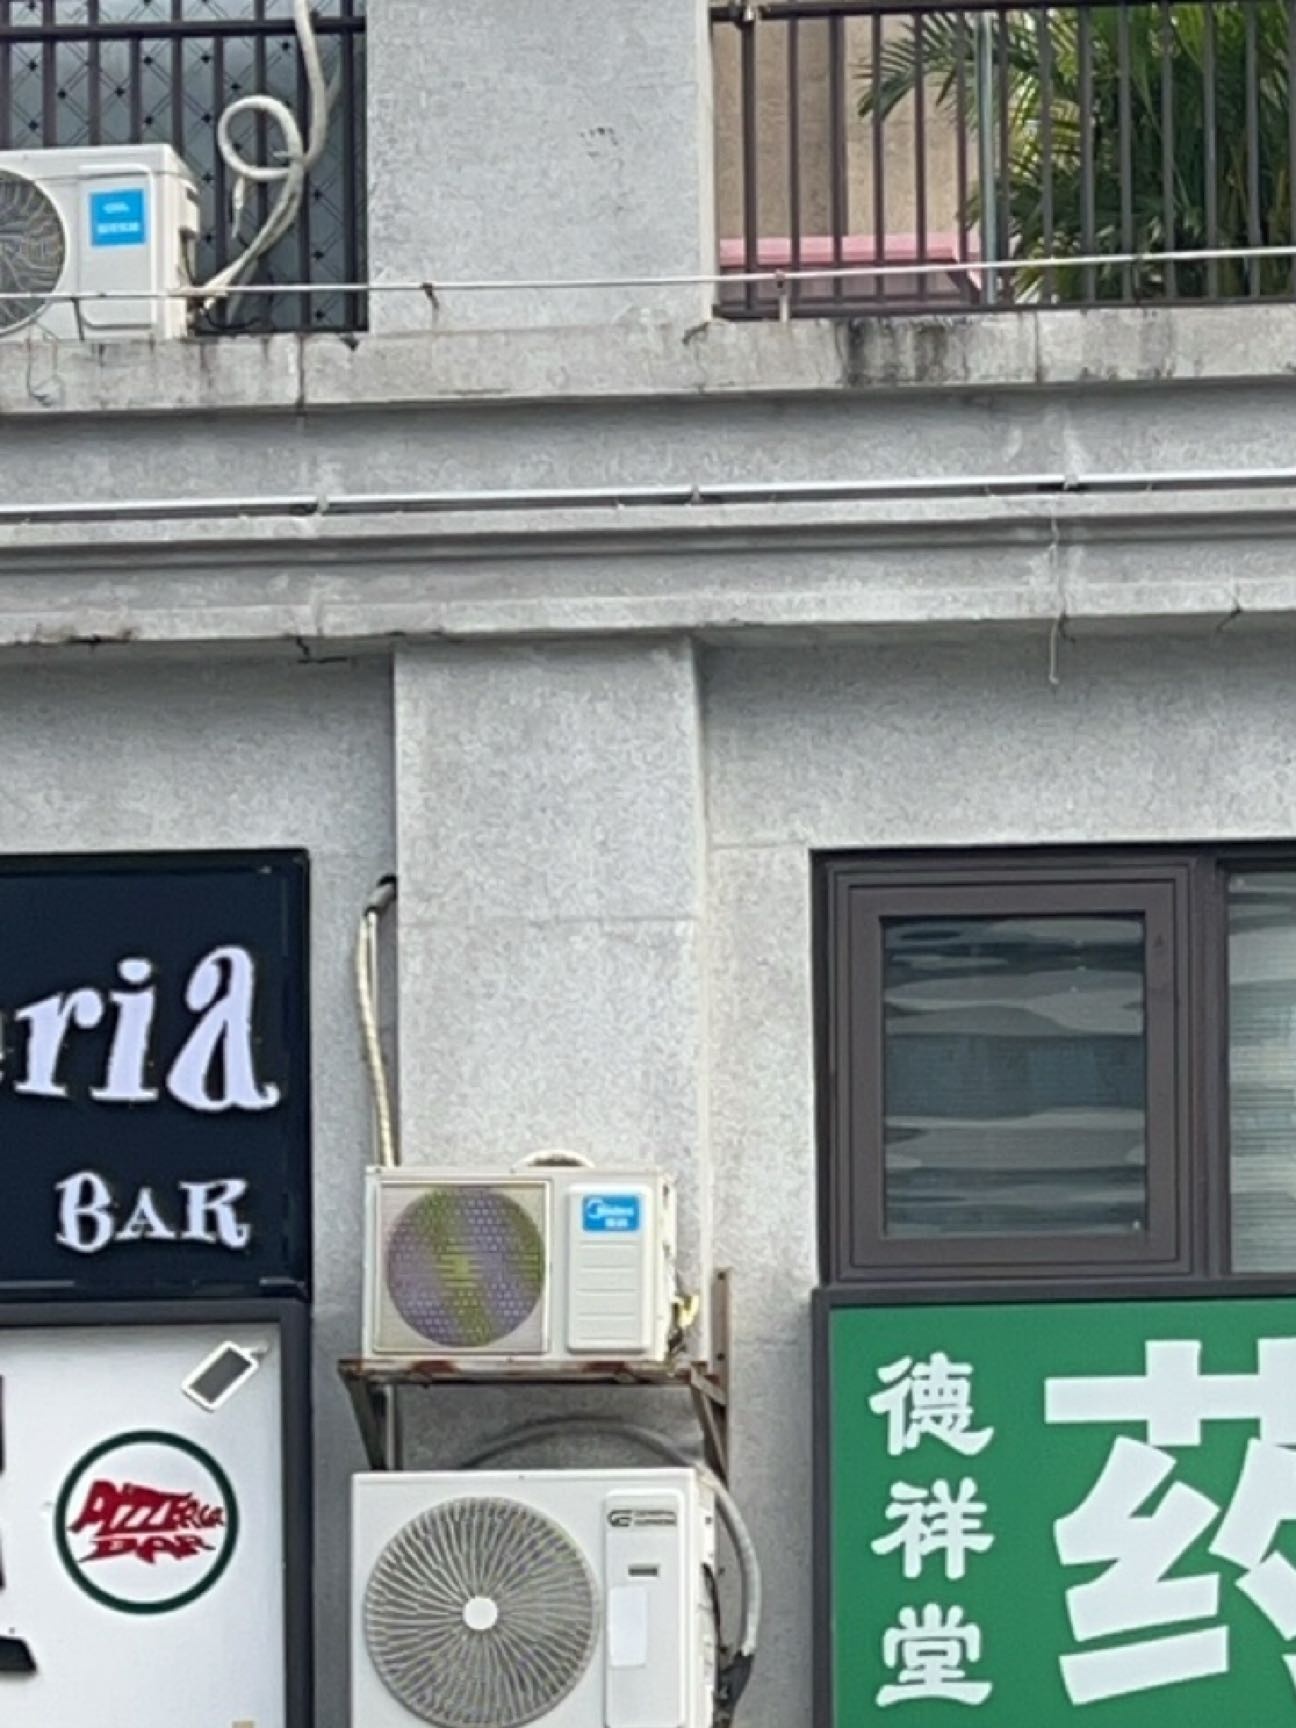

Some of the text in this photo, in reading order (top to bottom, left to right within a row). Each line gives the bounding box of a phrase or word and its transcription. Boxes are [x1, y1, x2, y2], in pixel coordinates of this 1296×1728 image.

[0, 946, 280, 1112] ria
[868, 1351, 995, 1708] 德祥堂
